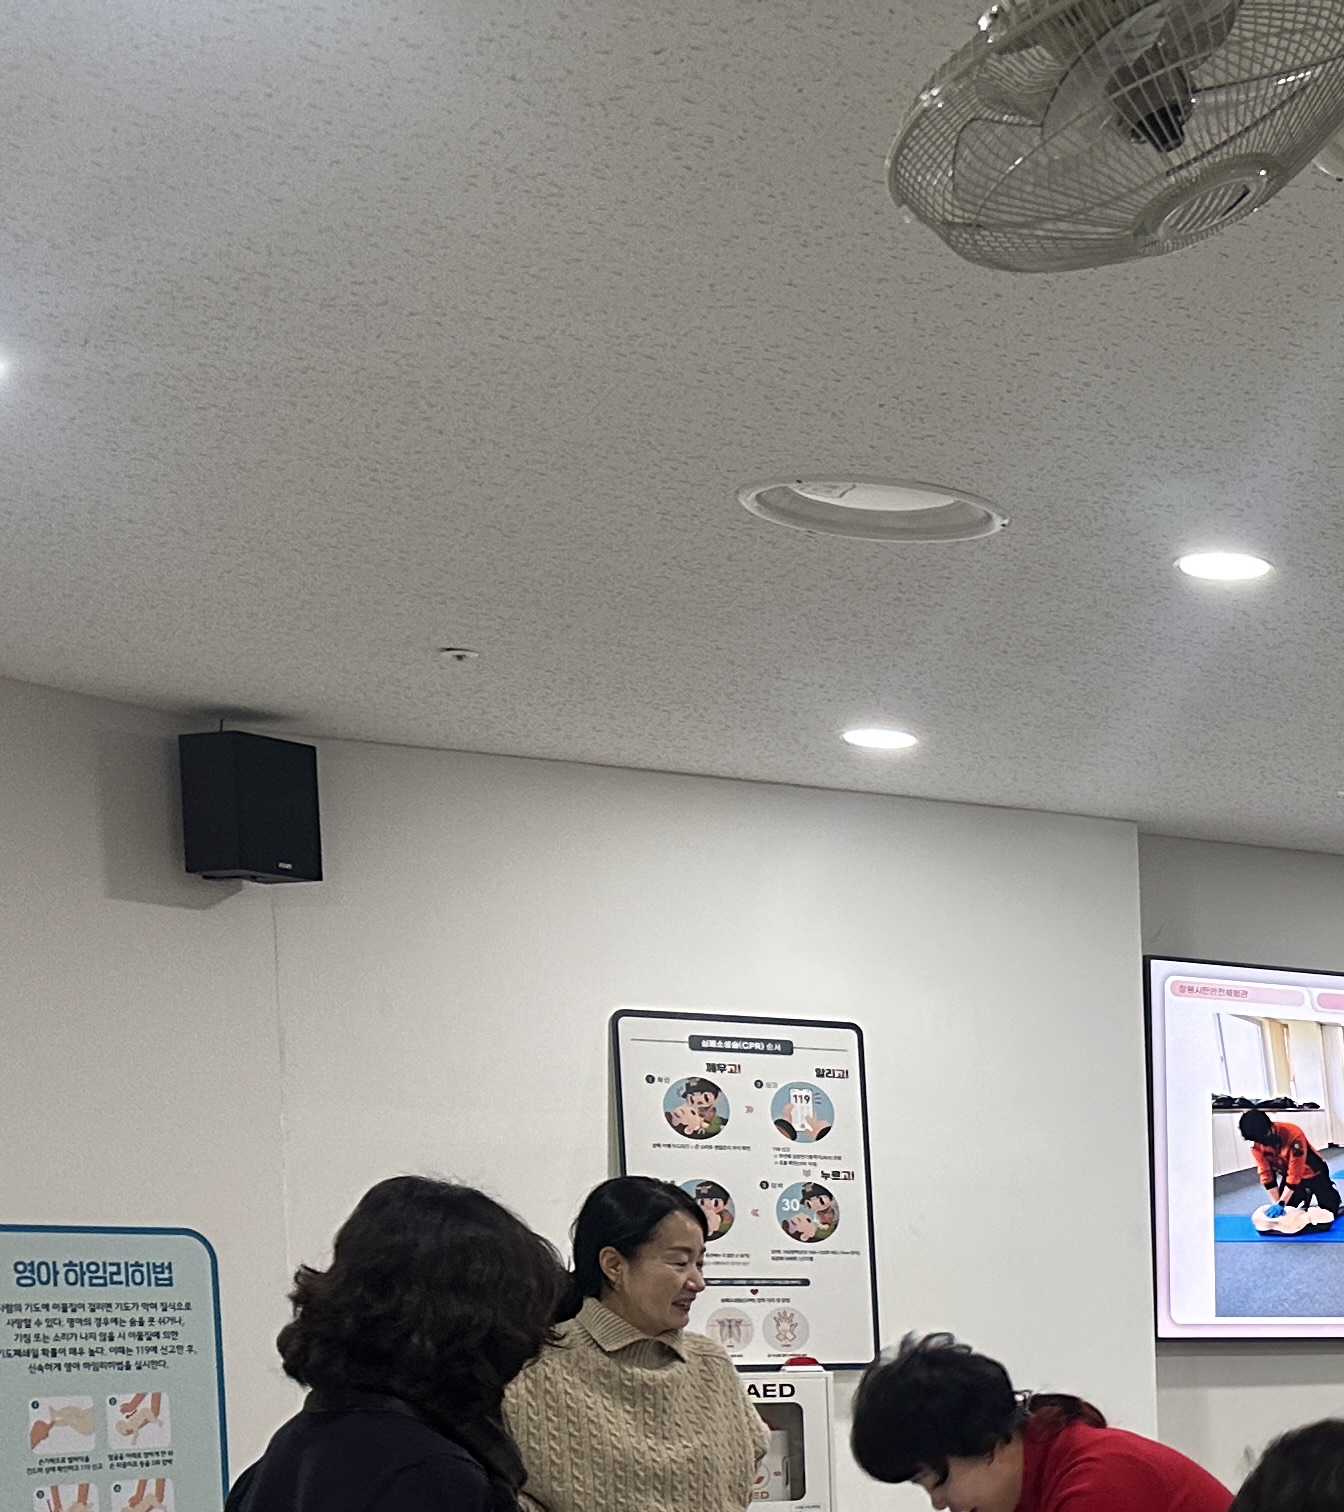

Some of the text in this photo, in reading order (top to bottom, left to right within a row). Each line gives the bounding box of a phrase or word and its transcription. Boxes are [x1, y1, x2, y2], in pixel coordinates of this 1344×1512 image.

[706, 1062, 741, 1074] 깨우고!
[815, 1068, 849, 1079] 알리고!
[793, 1094, 811, 1104] 119
[820, 1170, 854, 1181] 누르고!
[781, 1199, 799, 1211] 30
[13, 1260, 173, 1288] 영아 하임리히법
[34, 1318, 43, 1328] 수
[747, 1383, 796, 1398] AED
[752, 1491, 769, 1500] ED
